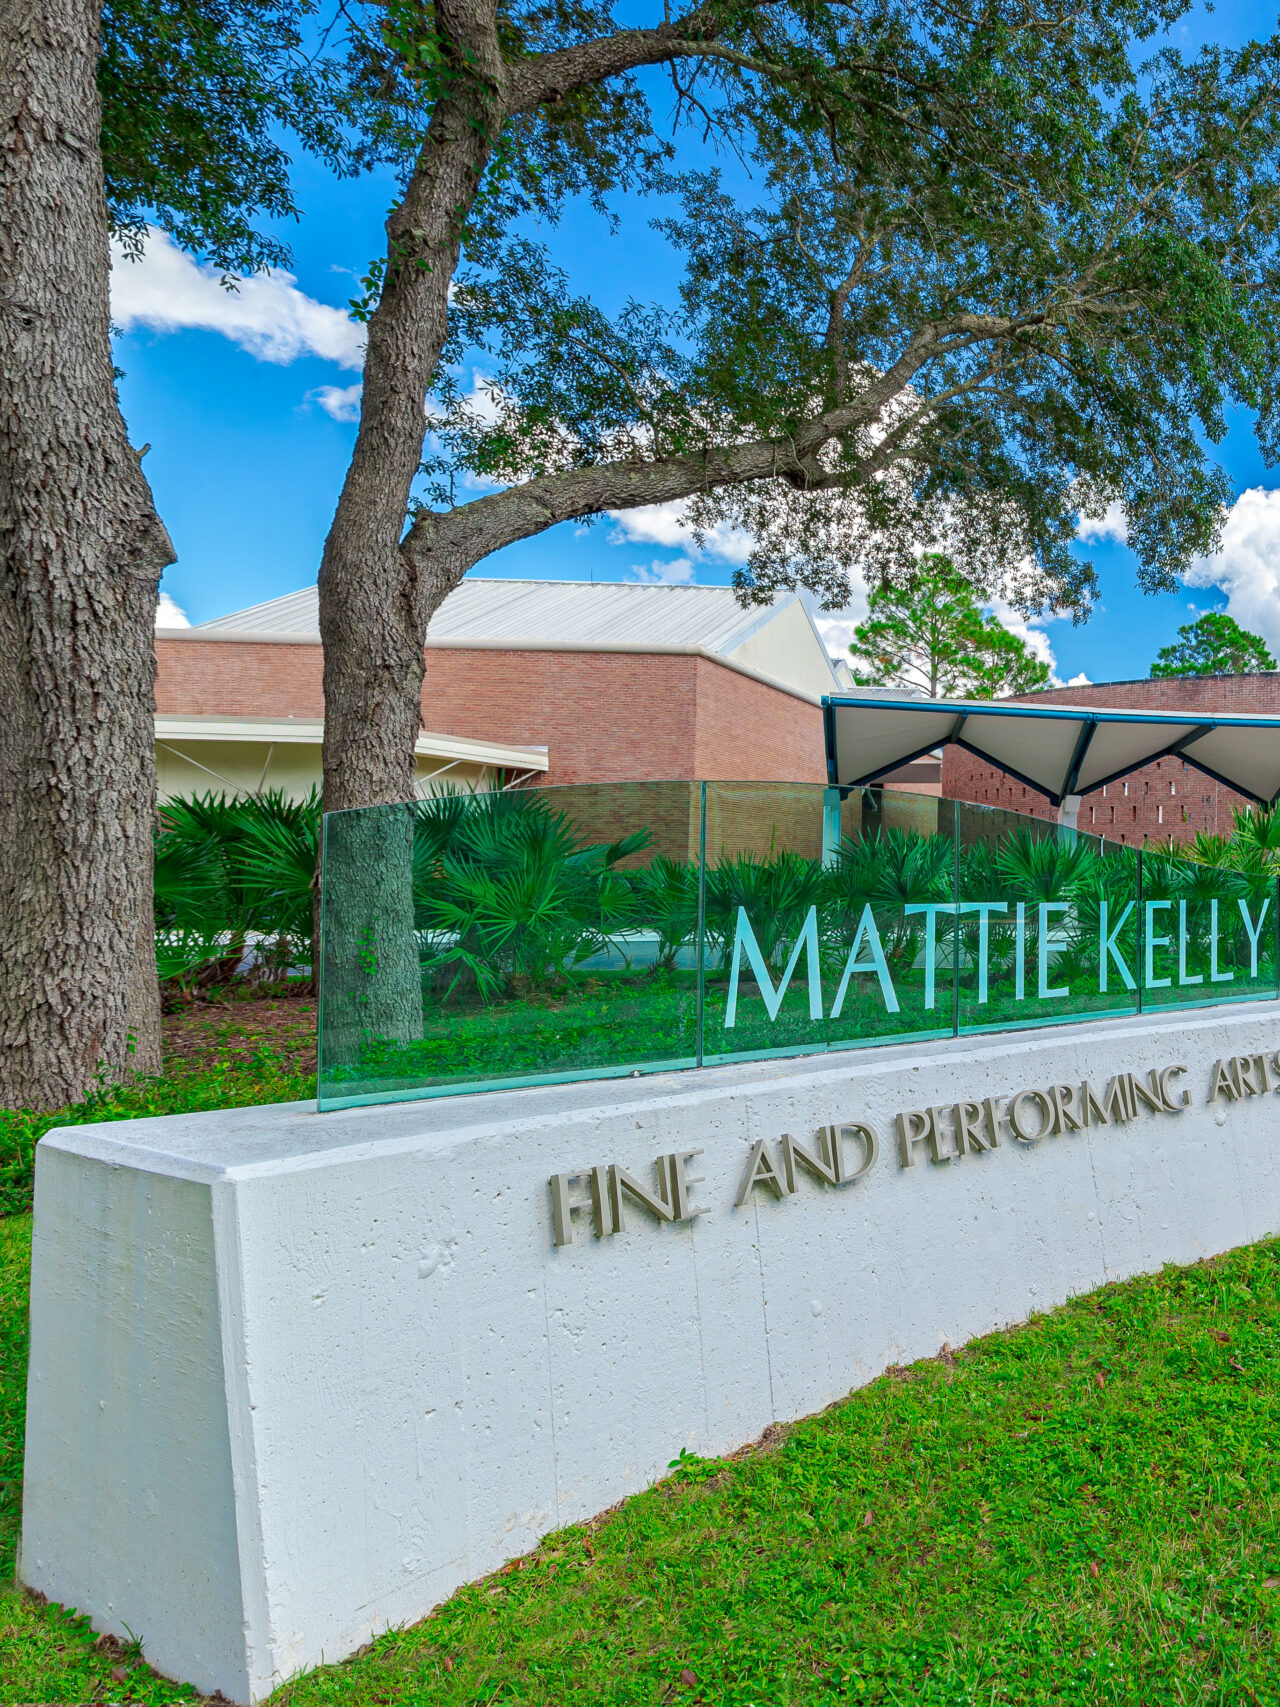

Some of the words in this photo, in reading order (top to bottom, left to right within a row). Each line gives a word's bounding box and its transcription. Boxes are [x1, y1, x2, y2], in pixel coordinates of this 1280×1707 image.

[724, 902, 1070, 1028] MATTIE
[1100, 898, 1270, 992] KELLY
[550, 1148, 711, 1246] FINE
[734, 1121, 880, 1207] AND
[896, 1065, 1193, 1168] PERFORMING
